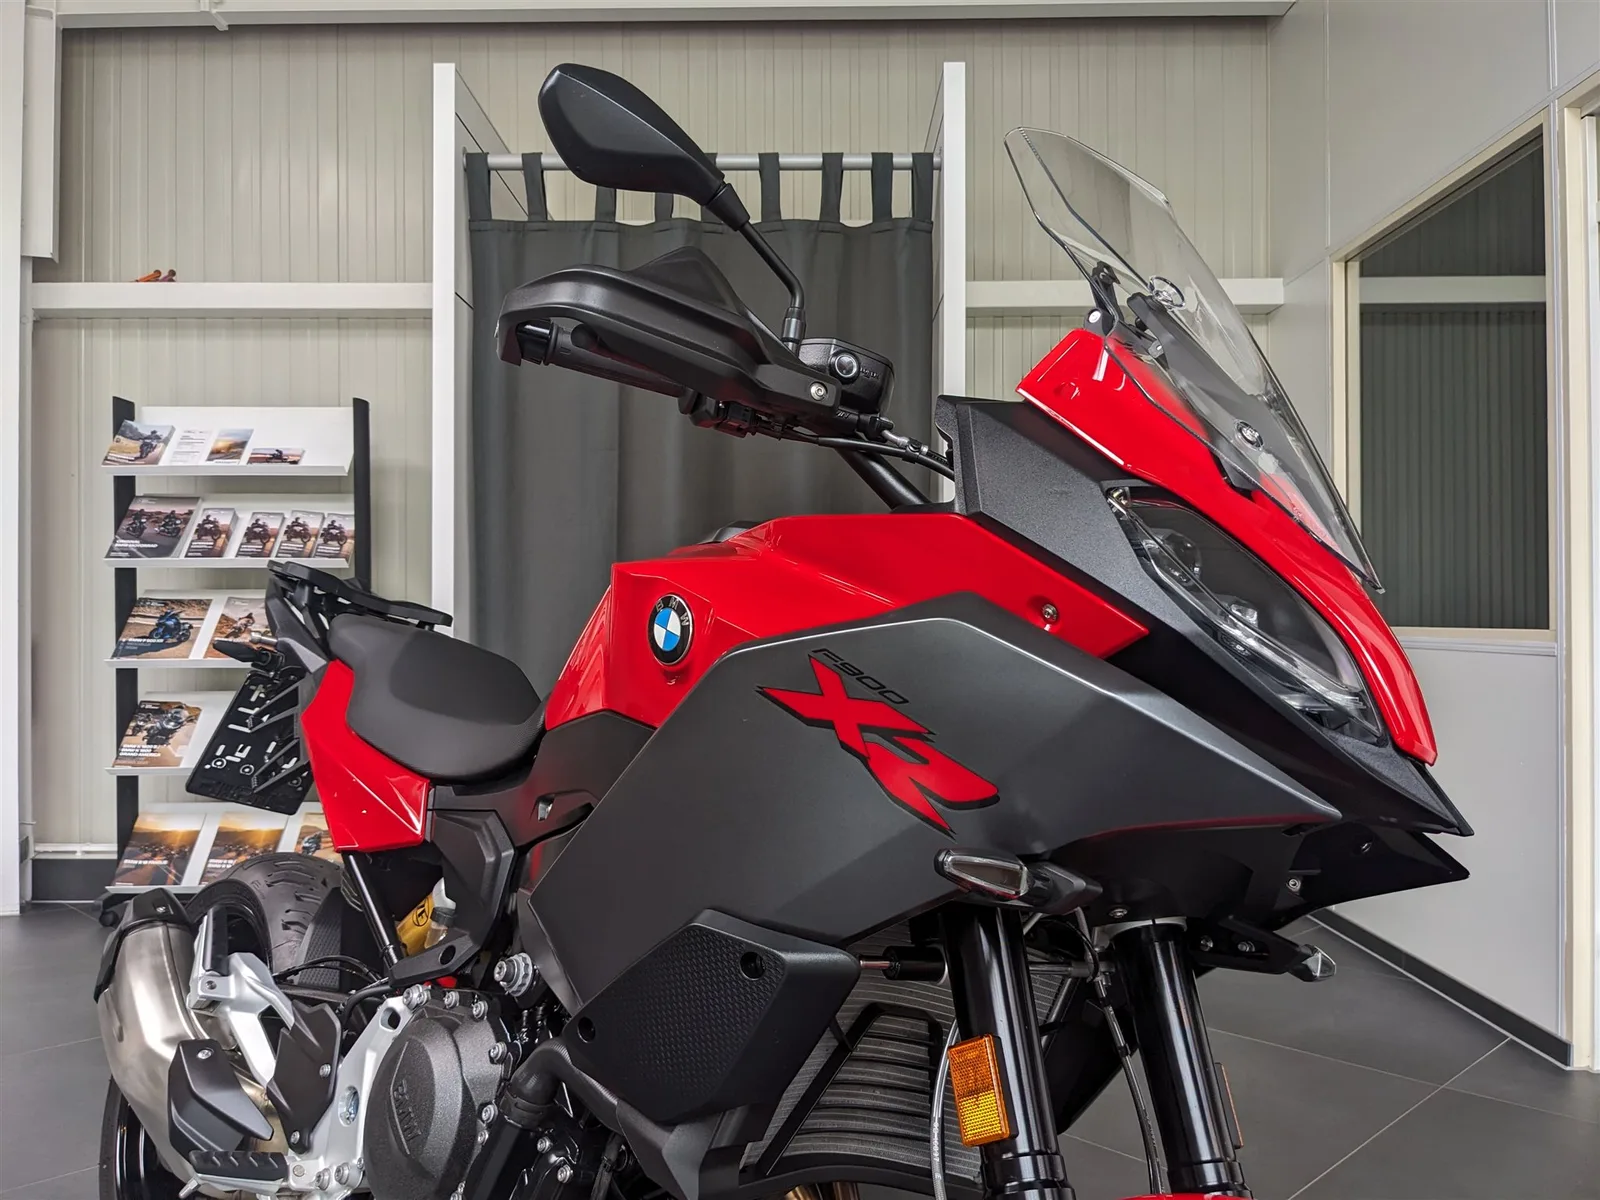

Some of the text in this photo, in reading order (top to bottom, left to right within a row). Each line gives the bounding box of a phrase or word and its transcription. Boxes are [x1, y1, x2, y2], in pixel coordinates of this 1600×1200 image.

[655, 596, 690, 626] BMW
[811, 648, 909, 705] F900
[754, 654, 1001, 841] XR
